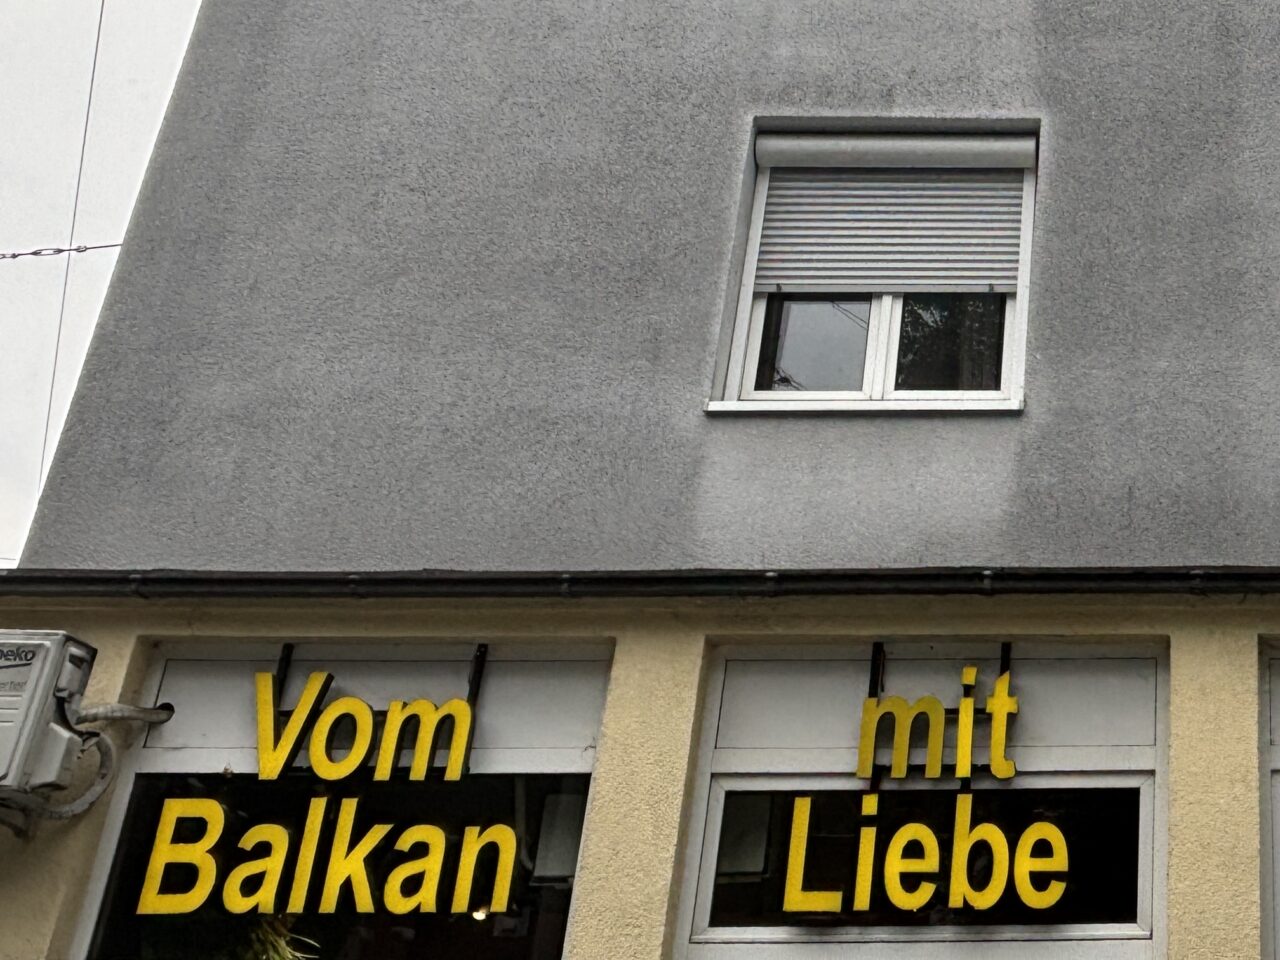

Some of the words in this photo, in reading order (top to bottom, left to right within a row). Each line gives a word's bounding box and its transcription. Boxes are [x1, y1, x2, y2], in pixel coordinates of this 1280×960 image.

[255, 671, 473, 782] Vom
[856, 665, 1019, 779] mit
[136, 797, 517, 915] Balkan
[782, 793, 1069, 912] Liebe
